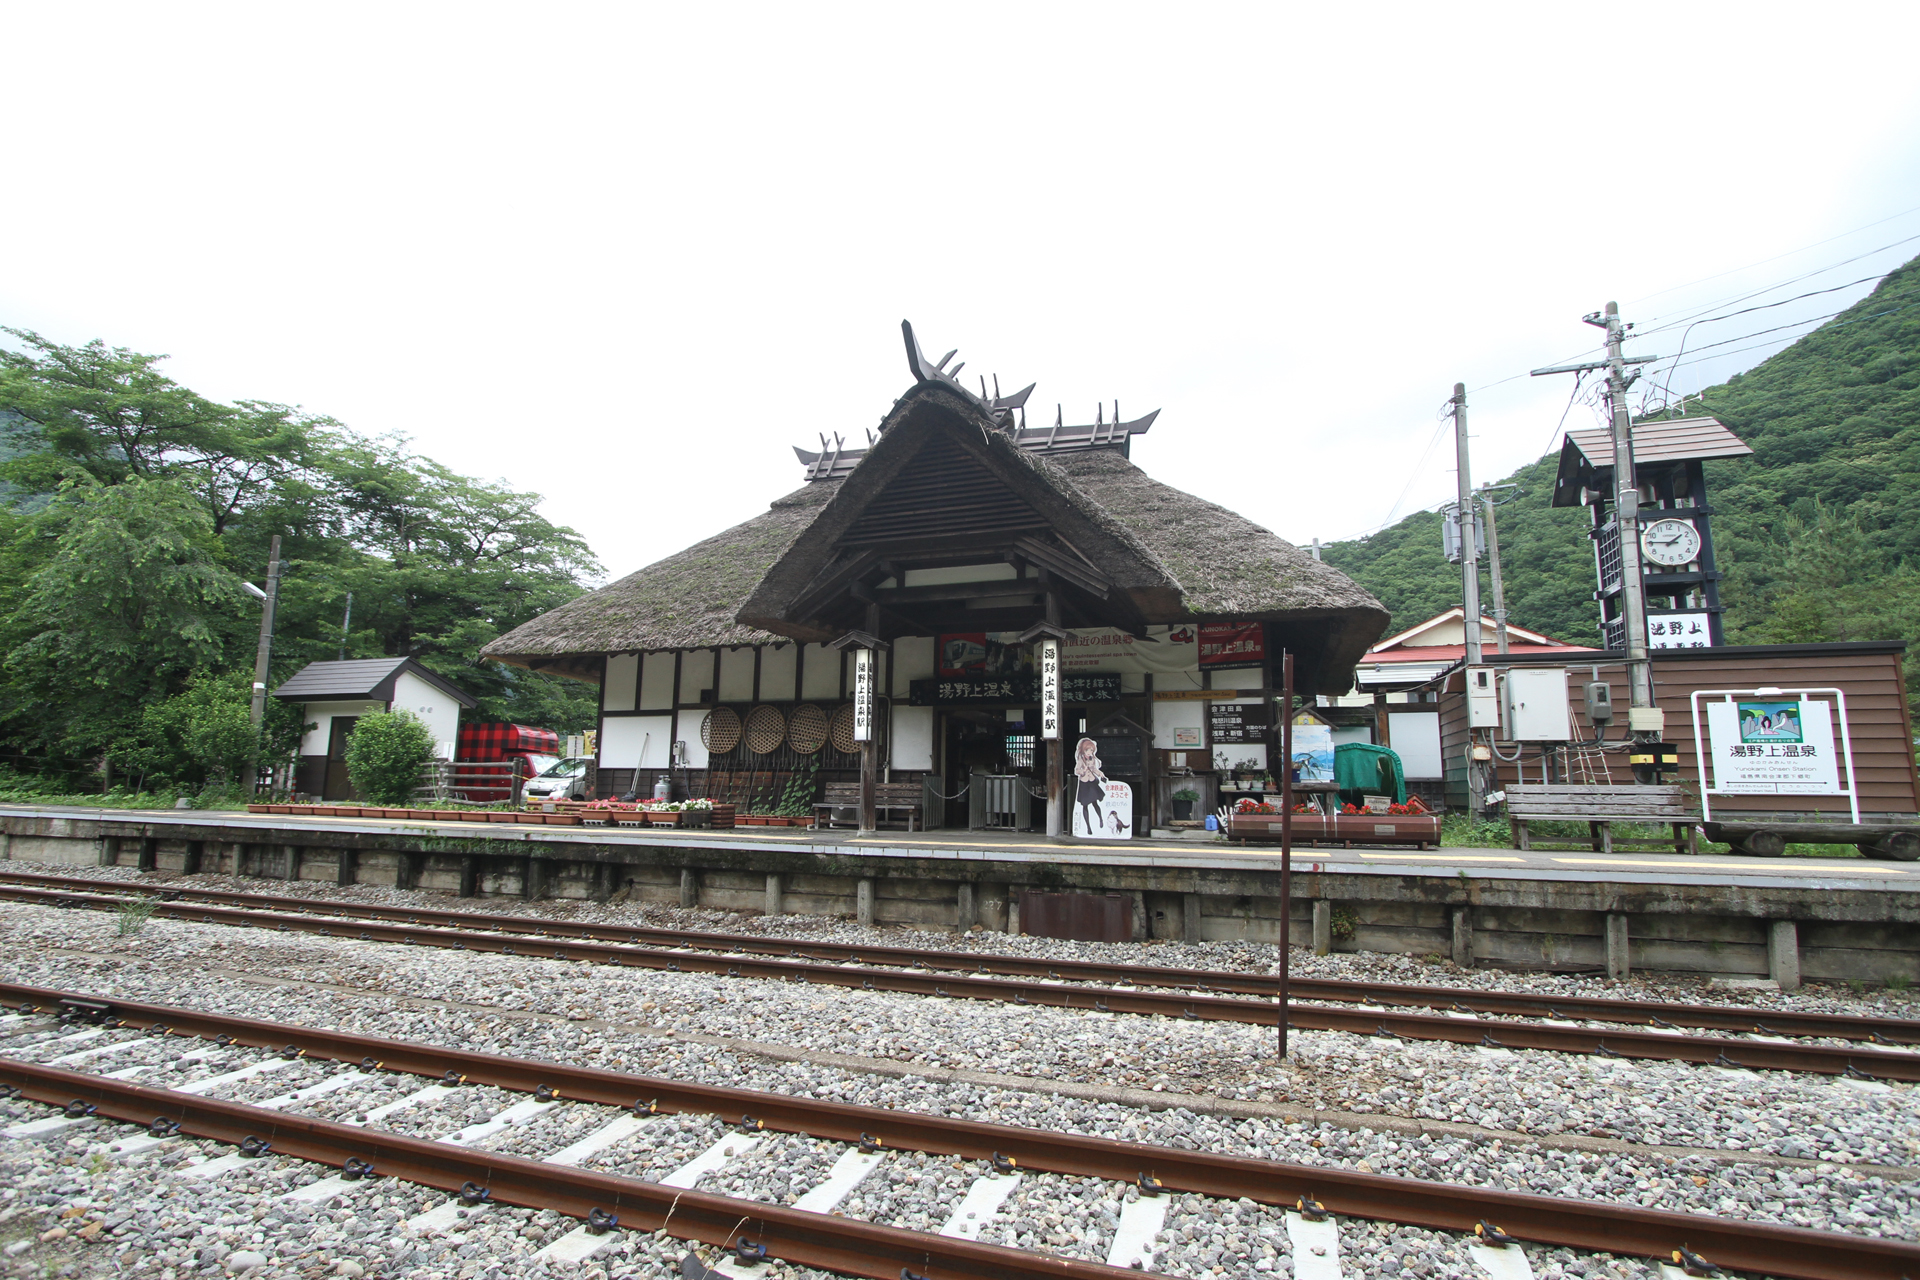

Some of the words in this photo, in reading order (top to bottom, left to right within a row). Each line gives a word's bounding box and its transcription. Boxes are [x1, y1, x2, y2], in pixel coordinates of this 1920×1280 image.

[1650, 620, 1703, 635] 湯野上
[856, 662, 866, 728] 湯野上温泉駅
[939, 680, 1014, 699] 湯野上温泉
[1044, 648, 1056, 730] 湯野上温泉駅
[1729, 744, 1818, 758] 湯野上温泉
